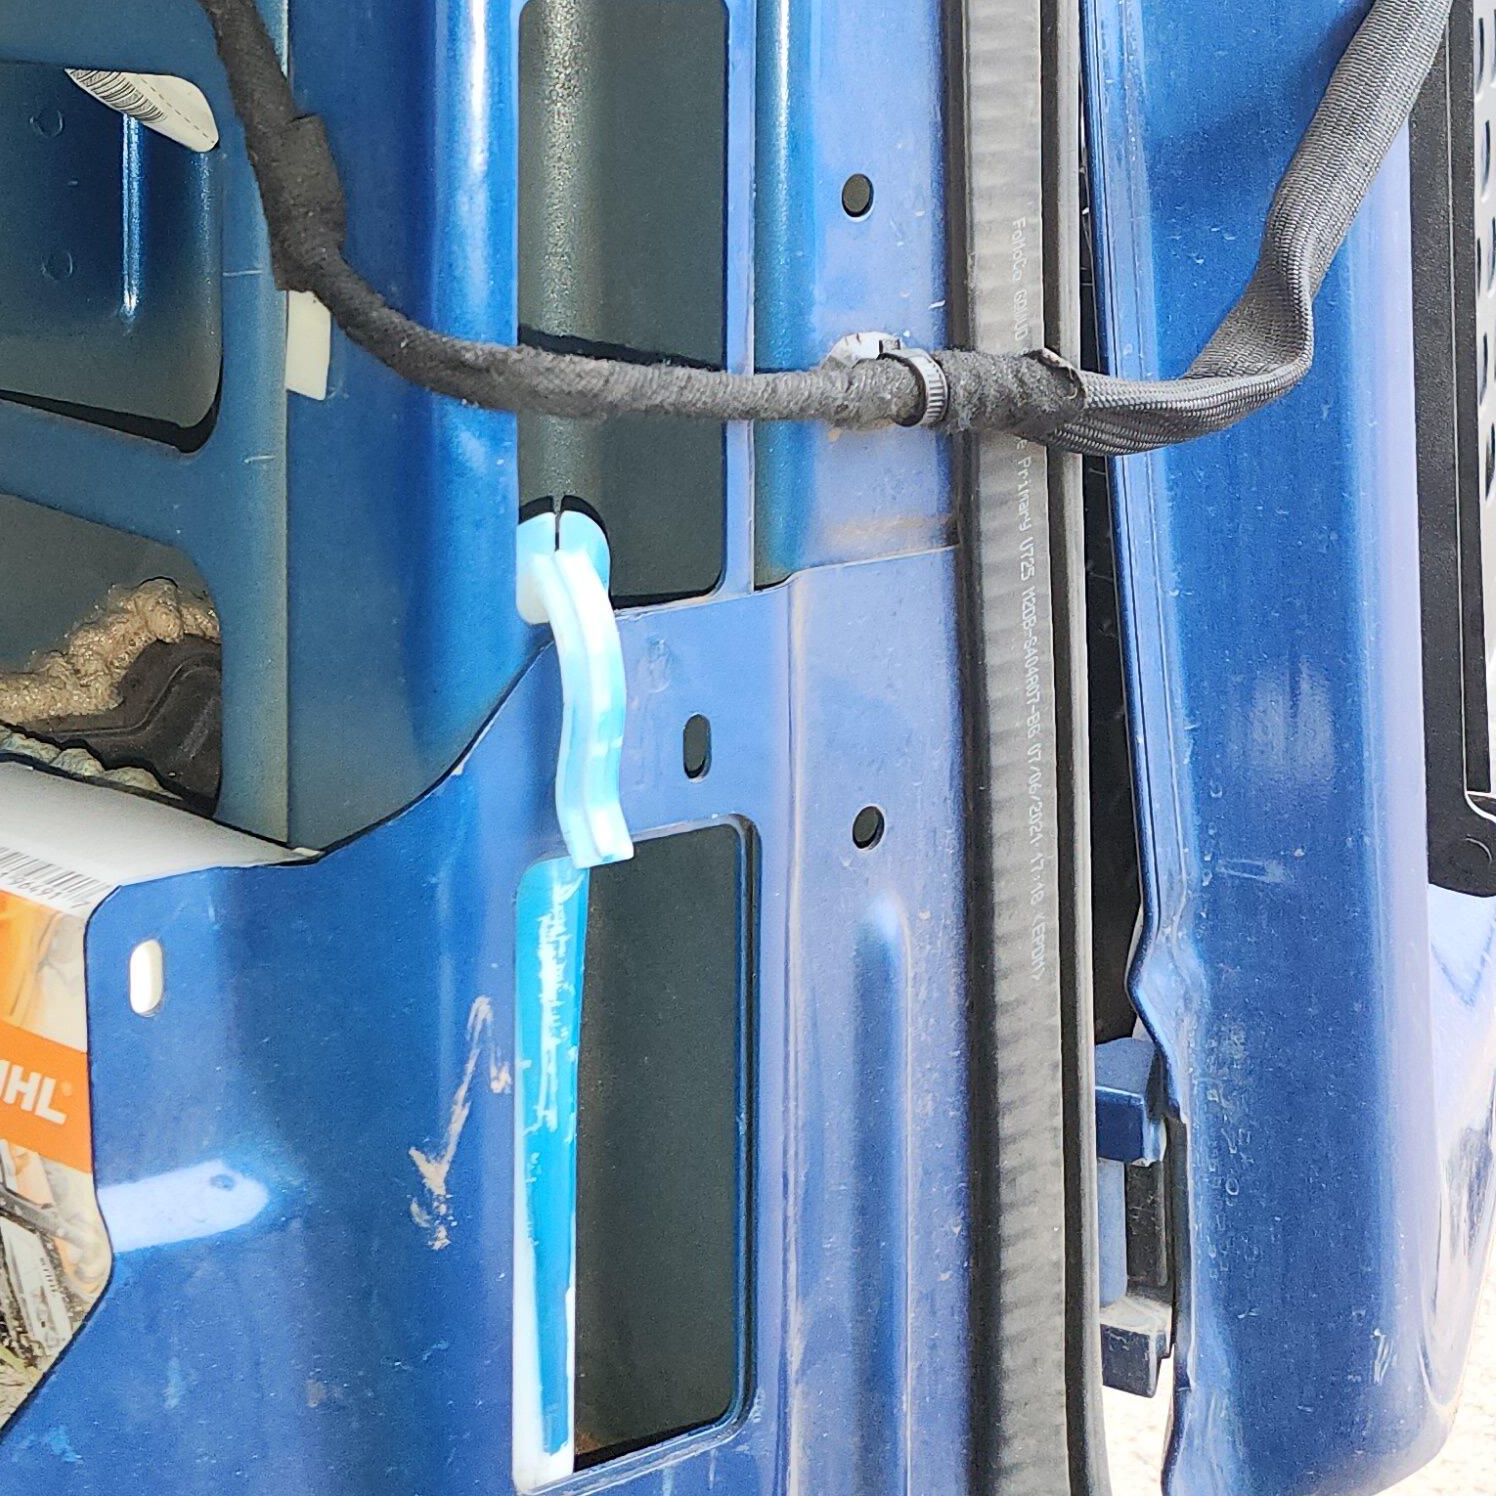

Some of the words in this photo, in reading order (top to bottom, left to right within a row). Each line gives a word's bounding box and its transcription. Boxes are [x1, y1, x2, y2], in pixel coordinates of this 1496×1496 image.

[1012, 217, 1025, 282] FoMoCo
[1017, 456, 1031, 531] Primary
[1019, 537, 1034, 582] U725
